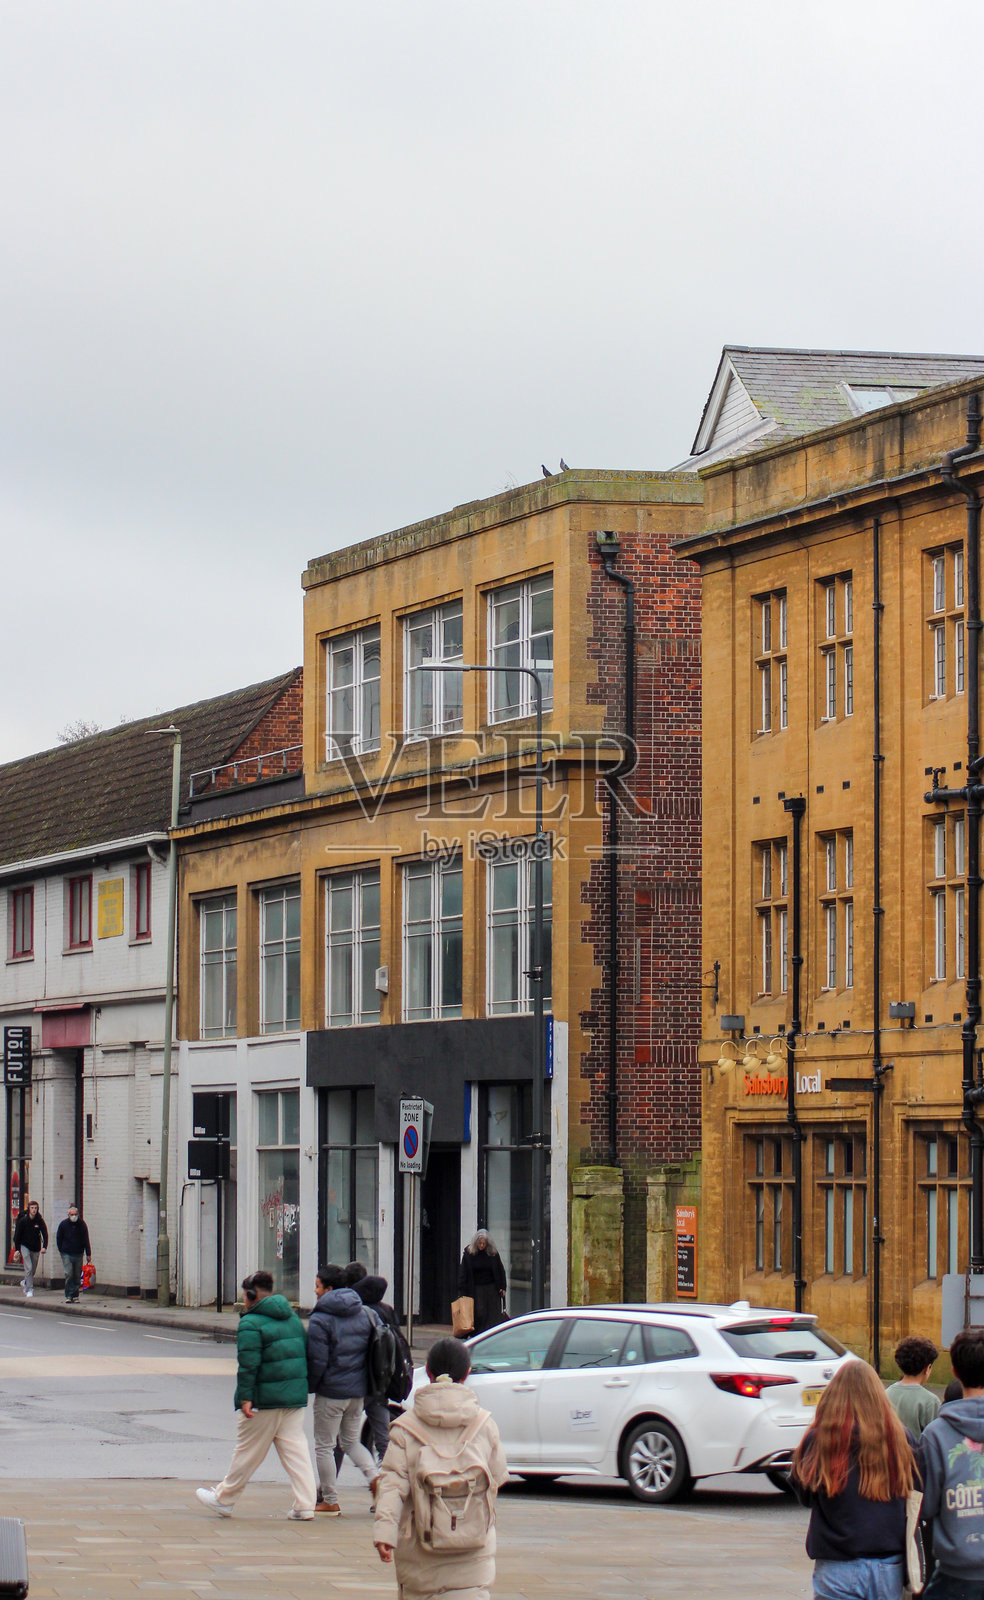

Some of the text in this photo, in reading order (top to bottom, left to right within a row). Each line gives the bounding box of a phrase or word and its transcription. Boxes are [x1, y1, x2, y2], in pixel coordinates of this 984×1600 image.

[796, 1068, 822, 1093] Local
[402, 1103, 422, 1111] Restricted
[404, 1113, 419, 1122] ZONE
[406, 1161, 421, 1170] loading
[946, 1483, 984, 1510] CÔTE
